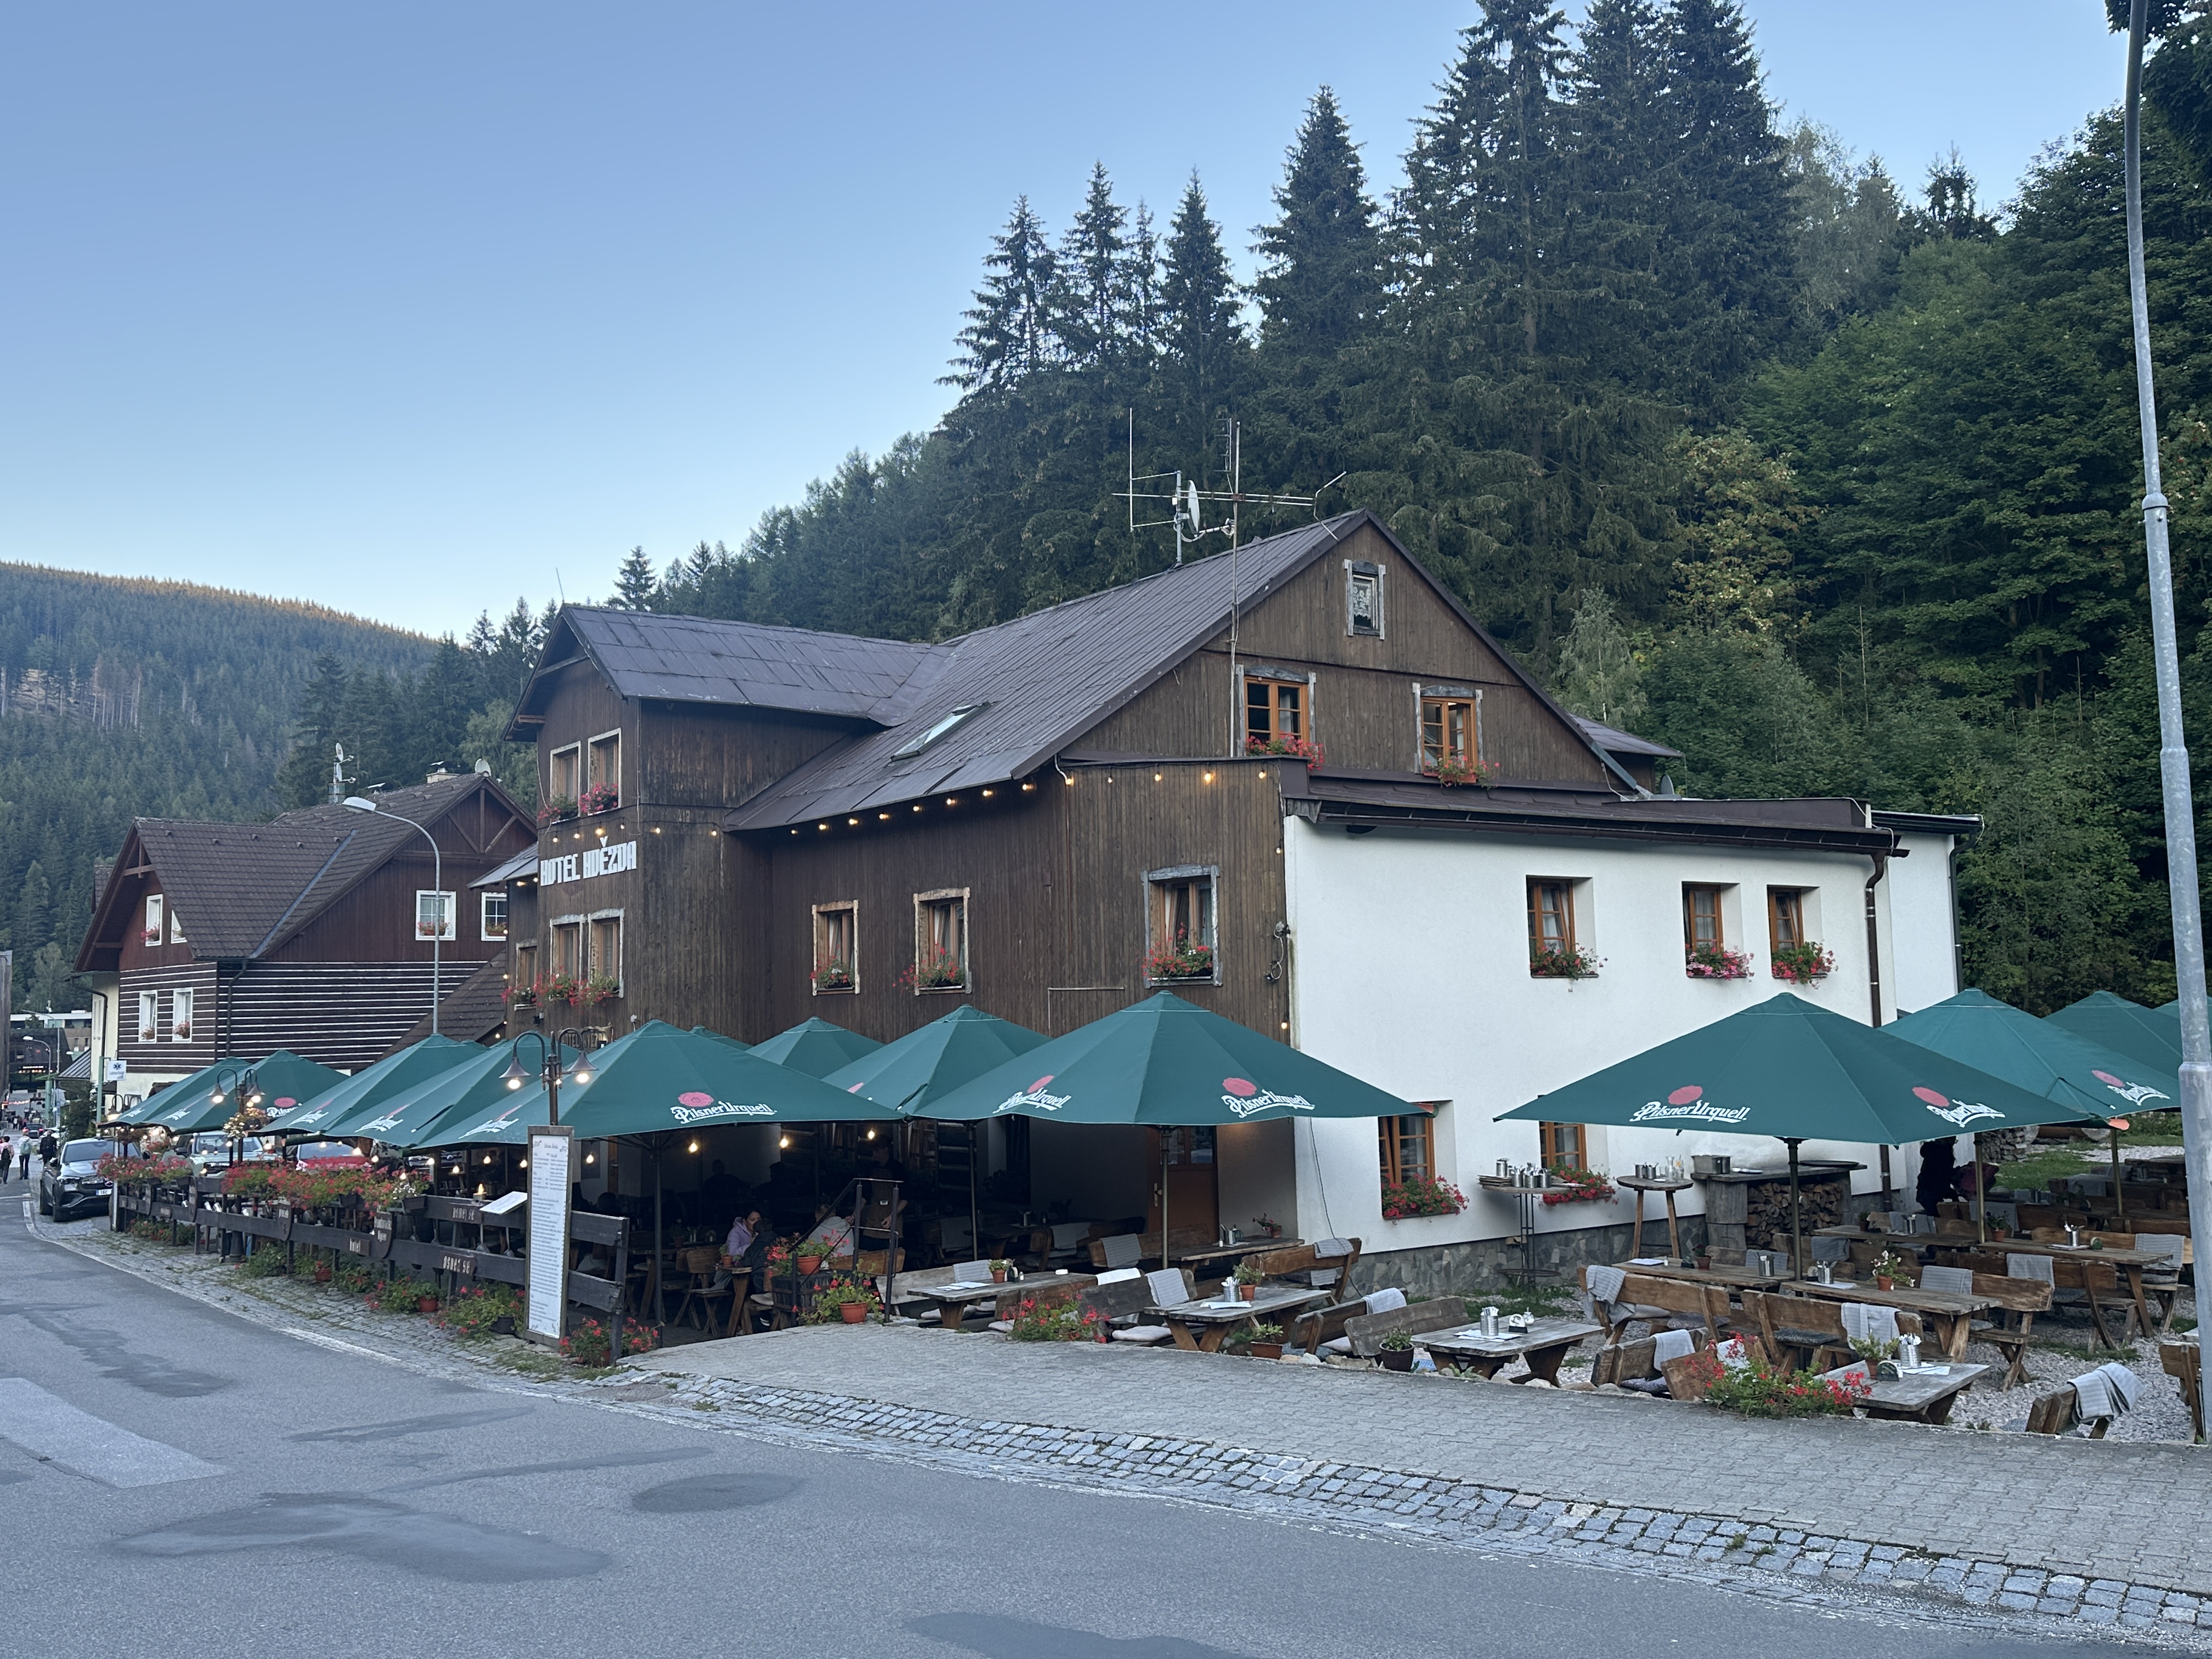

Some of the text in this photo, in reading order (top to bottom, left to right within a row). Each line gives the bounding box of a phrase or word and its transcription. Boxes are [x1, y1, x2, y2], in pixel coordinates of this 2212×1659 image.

[540, 853, 580, 887] HOTEL
[1031, 1087, 1072, 1109] Urquell
[1221, 1089, 1316, 1118] Pilsner Urquell
[670, 1101, 778, 1124] Pilsner Urquell
[1629, 1099, 1751, 1122] Pilsner Urquell
